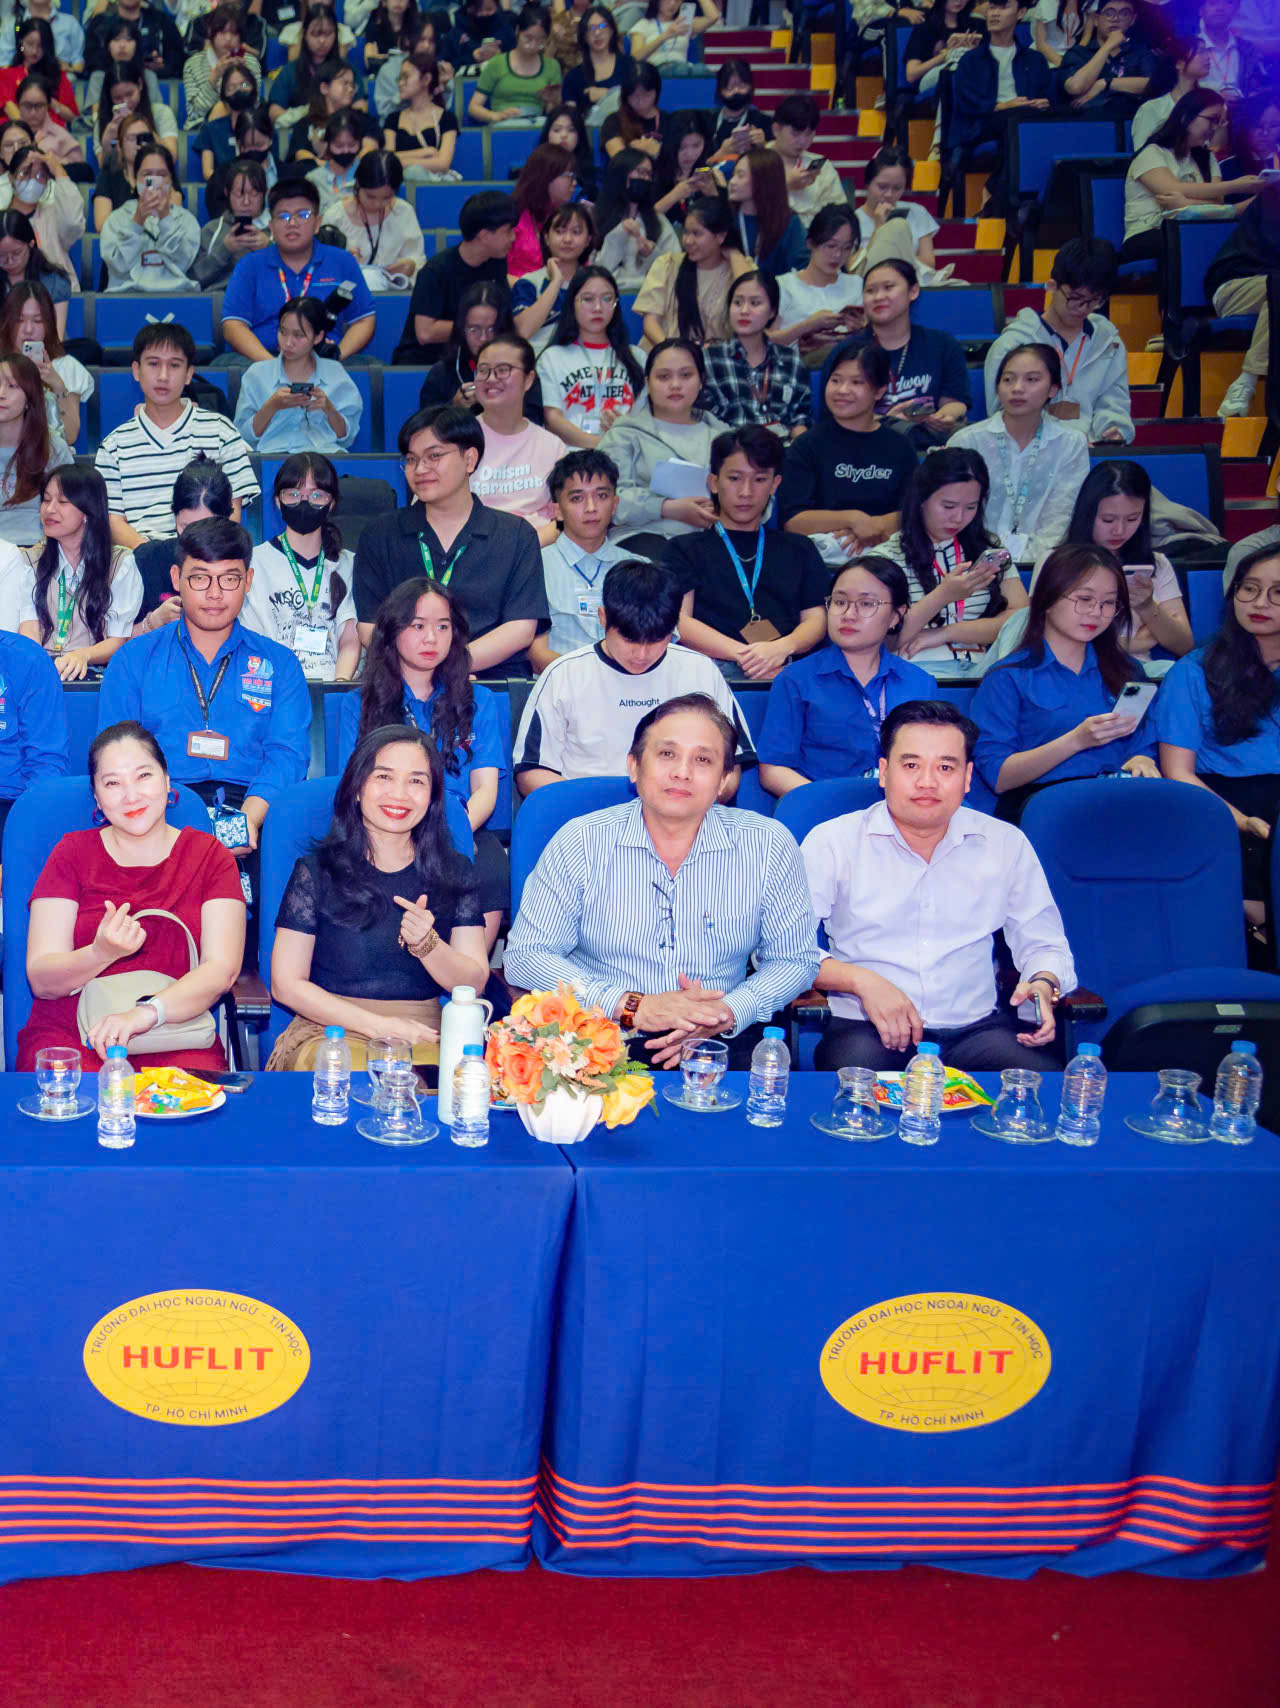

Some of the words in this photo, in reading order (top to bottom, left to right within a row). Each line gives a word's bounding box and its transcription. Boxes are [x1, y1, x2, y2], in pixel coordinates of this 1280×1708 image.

[834, 463, 892, 483] Slyder
[619, 698, 660, 707] Althought
[153, 1296, 181, 1310] HỌC
[269, 1315, 288, 1333] TIN
[894, 1300, 923, 1314] HỌC
[1011, 1317, 1029, 1335] TIN
[123, 1345, 274, 1371] HUFLIT
[859, 1350, 1014, 1375] HUFLIT
[215, 1404, 249, 1419] MINH
[950, 1409, 985, 1425] MINH
